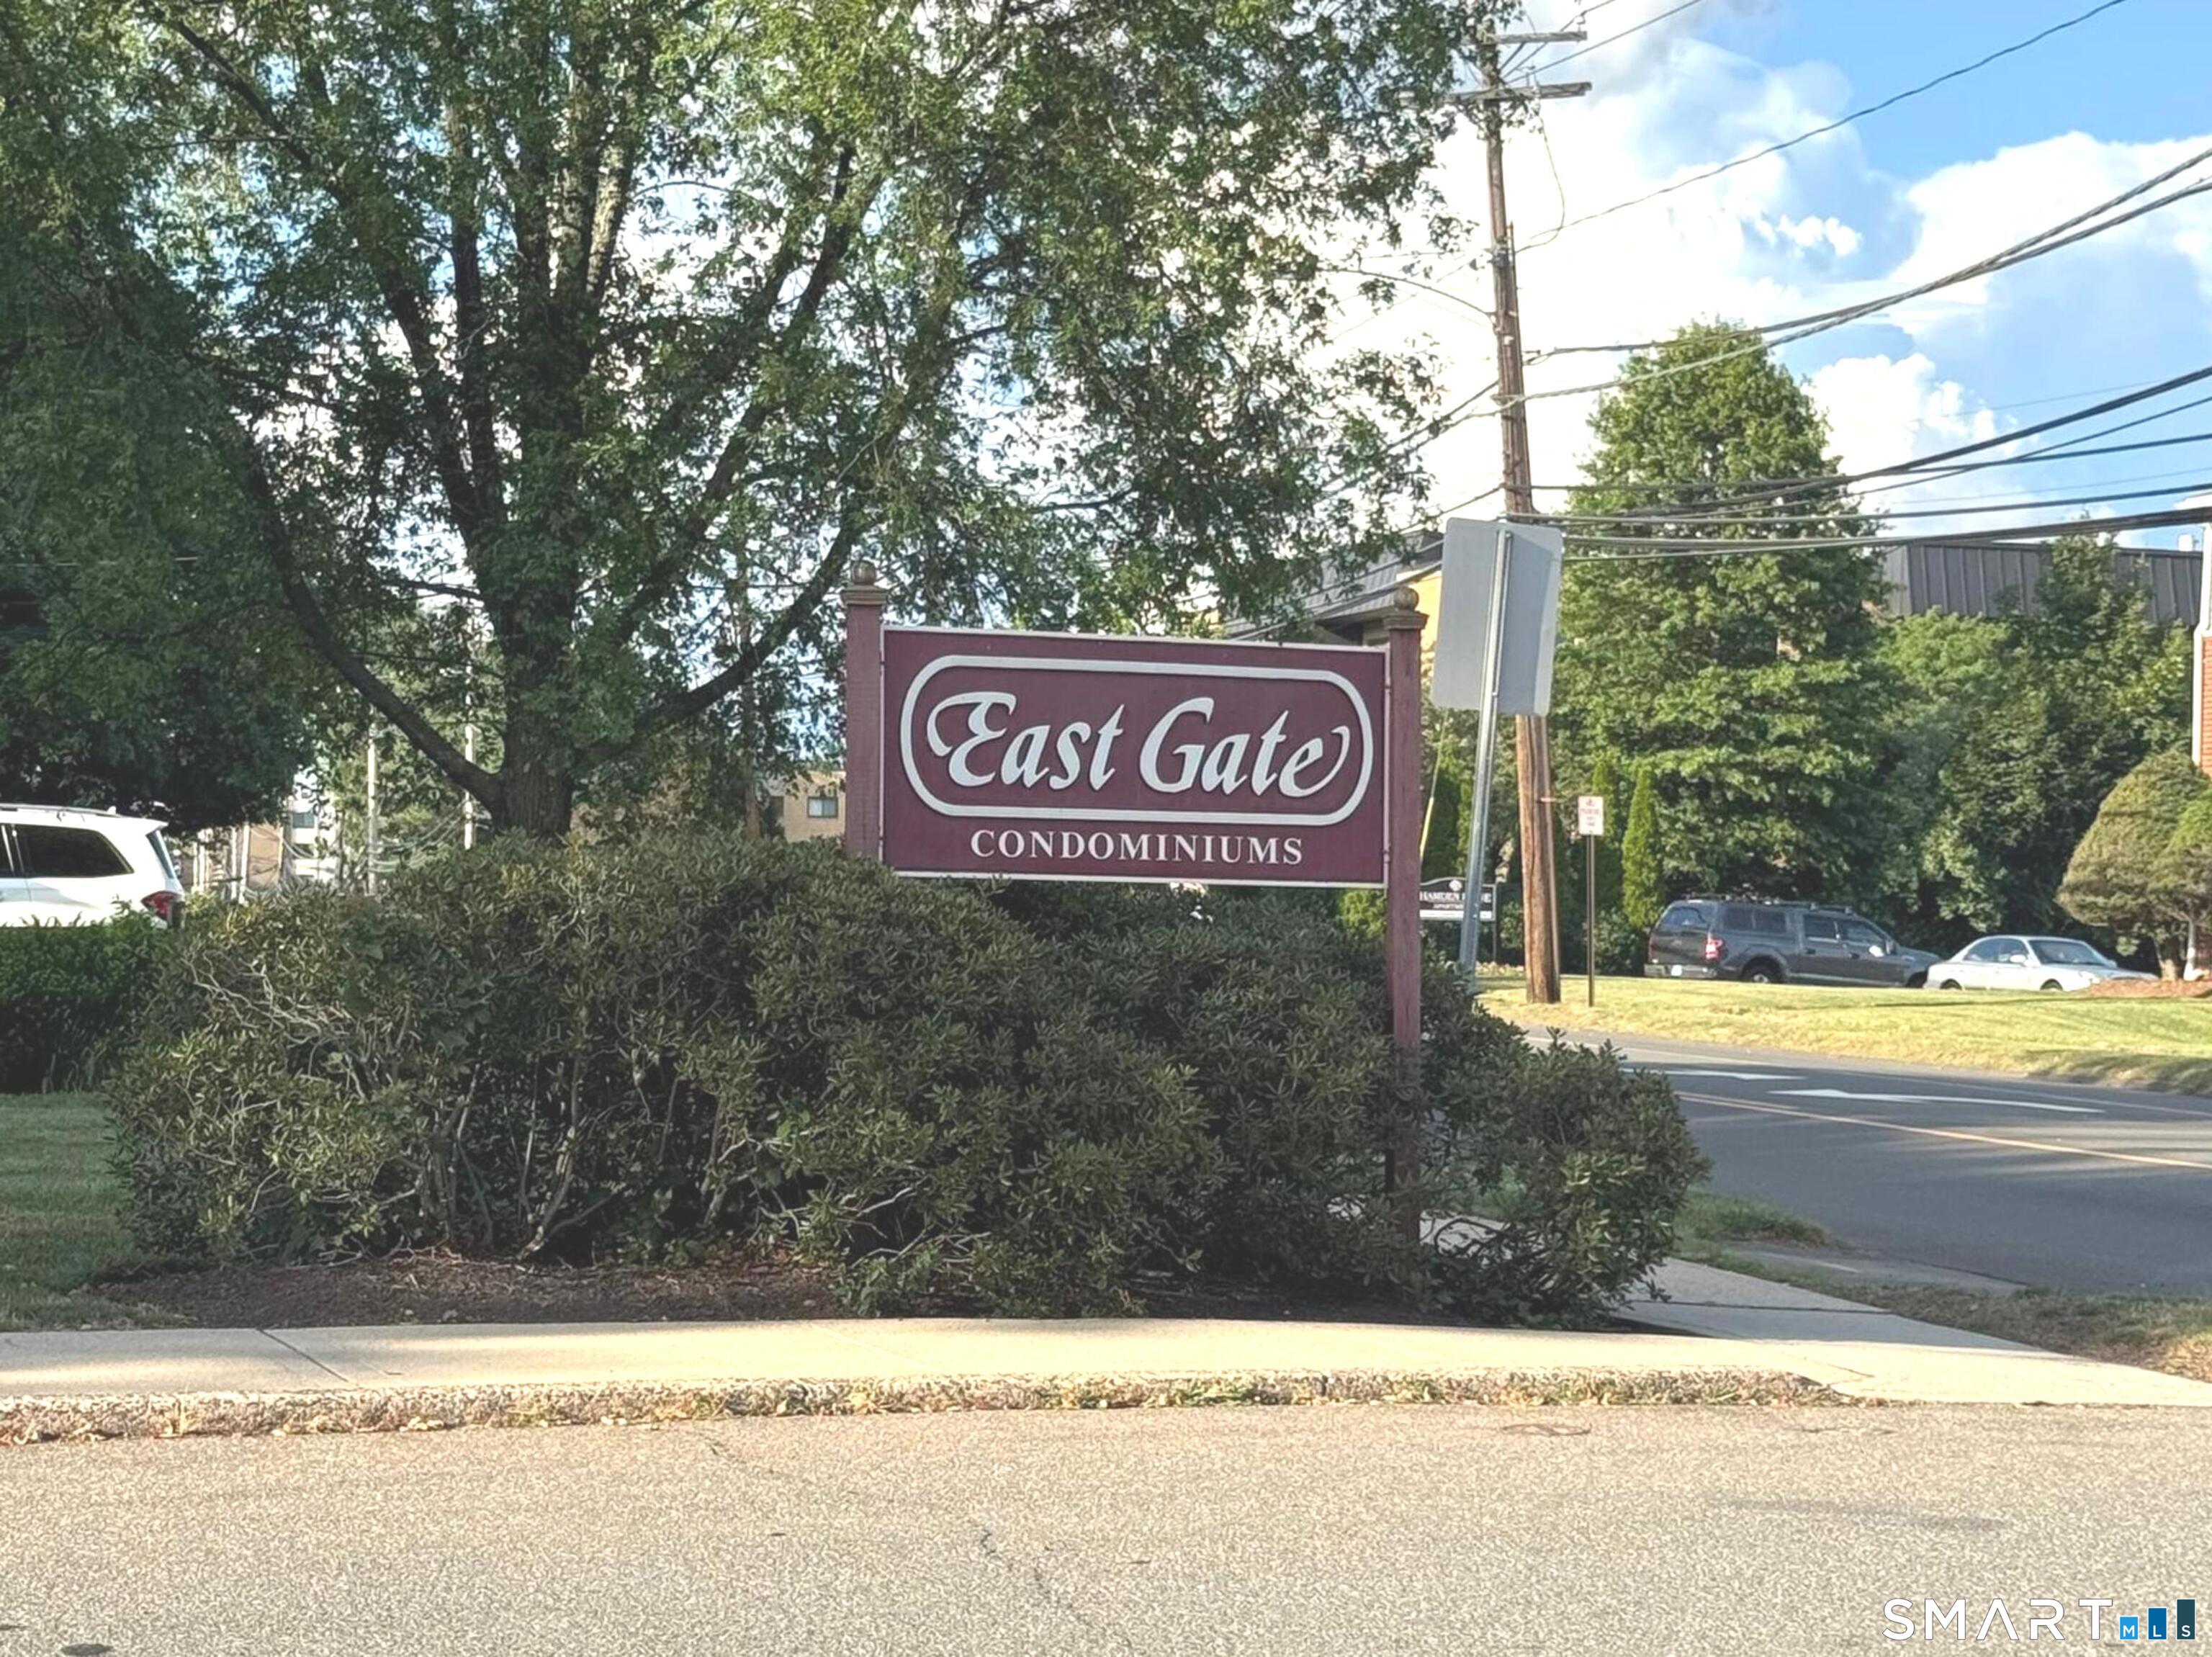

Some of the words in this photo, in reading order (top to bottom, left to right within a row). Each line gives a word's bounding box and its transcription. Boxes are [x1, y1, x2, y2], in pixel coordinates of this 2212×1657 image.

[927, 691, 1125, 791] East
[1140, 697, 1350, 797] Gate
[971, 830, 1303, 866] CONDOMINIUMS
